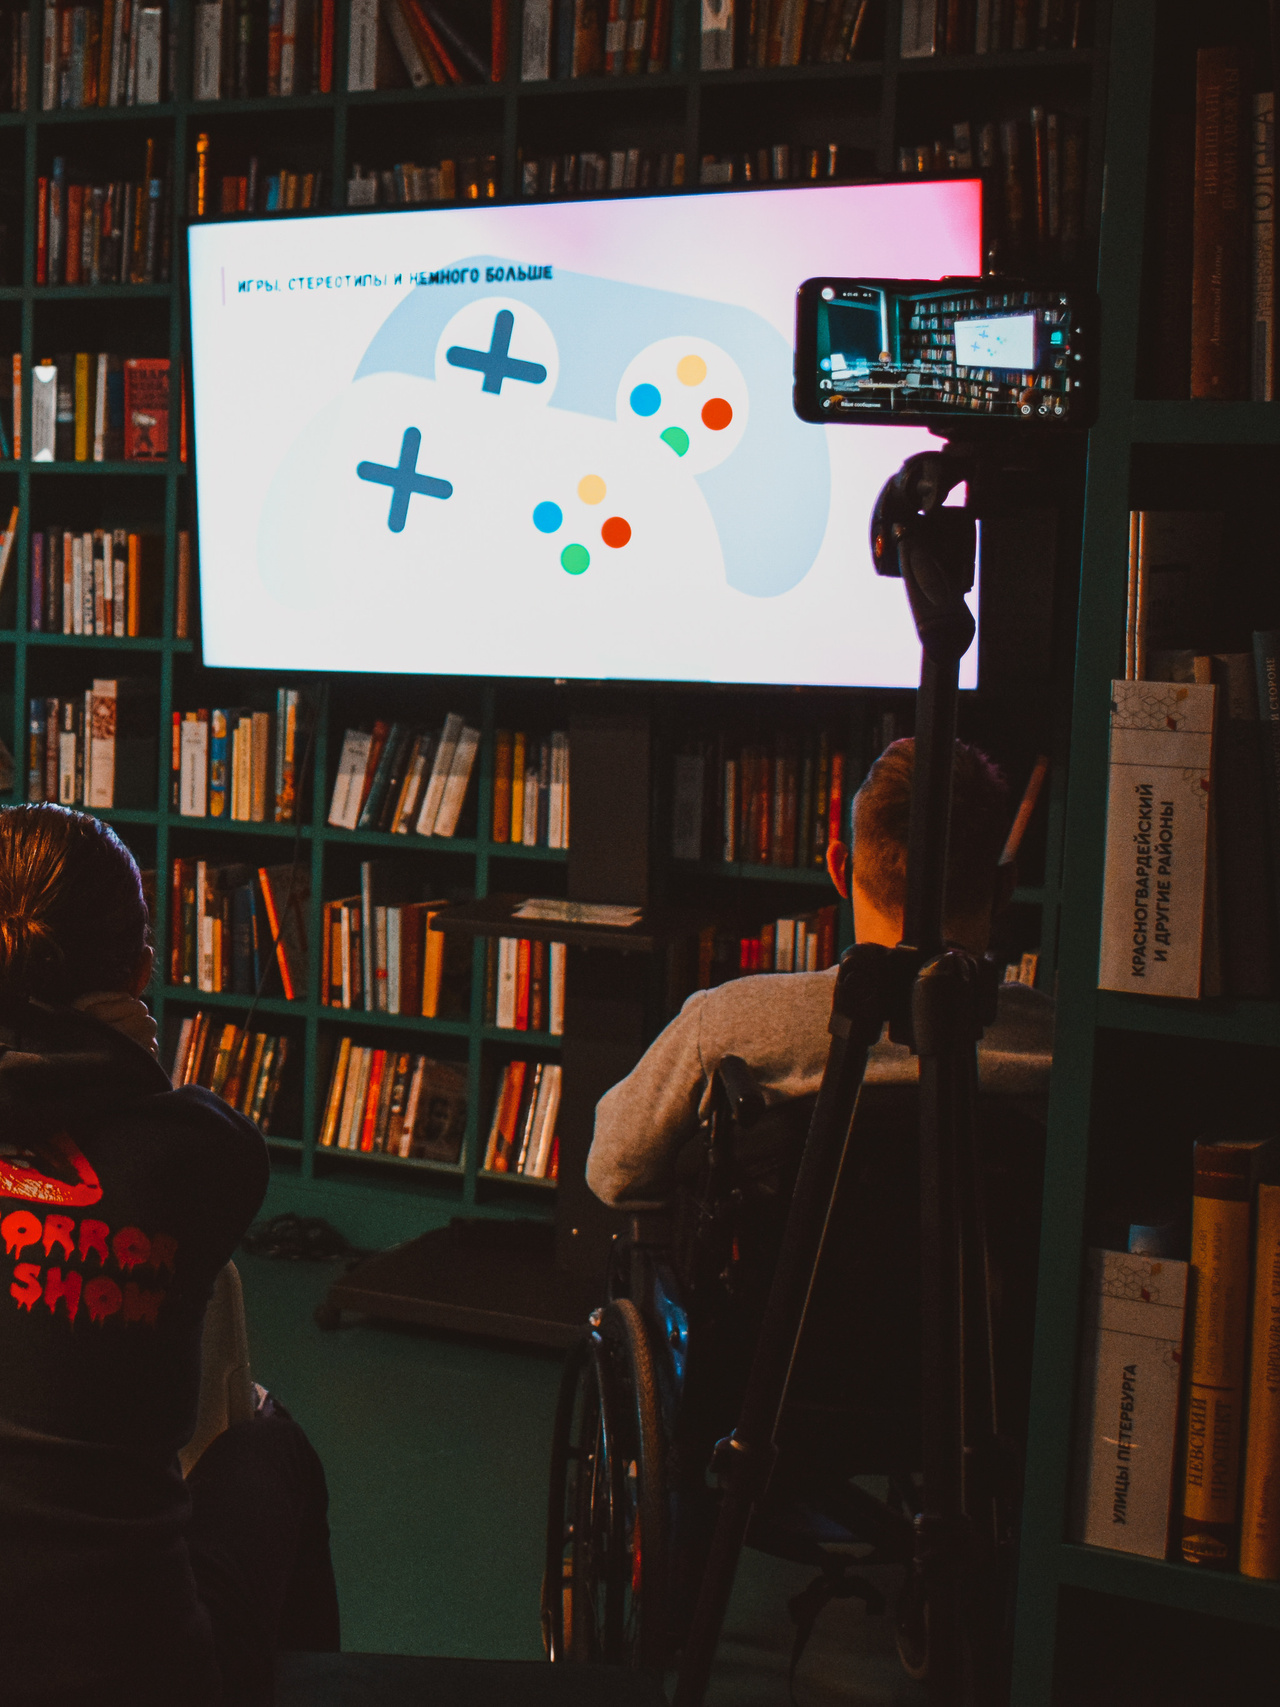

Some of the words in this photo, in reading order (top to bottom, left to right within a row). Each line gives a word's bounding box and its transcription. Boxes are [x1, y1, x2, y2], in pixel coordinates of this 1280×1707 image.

[287, 273, 388, 291] СТЕРЕОТИПЫ
[393, 273, 403, 287] И
[409, 267, 480, 287] НЕМНОГО
[485, 264, 554, 283] БОЛЬШЕ
[1266, 657, 1279, 710] СТОРОНЕ
[1155, 800, 1174, 876] РАЙОНЫ
[1131, 783, 1154, 978] КРАСНОГВАРДЕЙСКИЙ
[1155, 880, 1172, 947] ДРУГИЕ
[1154, 949, 1168, 963] И
[9, 1262, 167, 1331] SHOW
[1118, 1363, 1137, 1460] ПЕТЕРБУРГА
[1112, 1464, 1129, 1525] УЛИЦЫ
